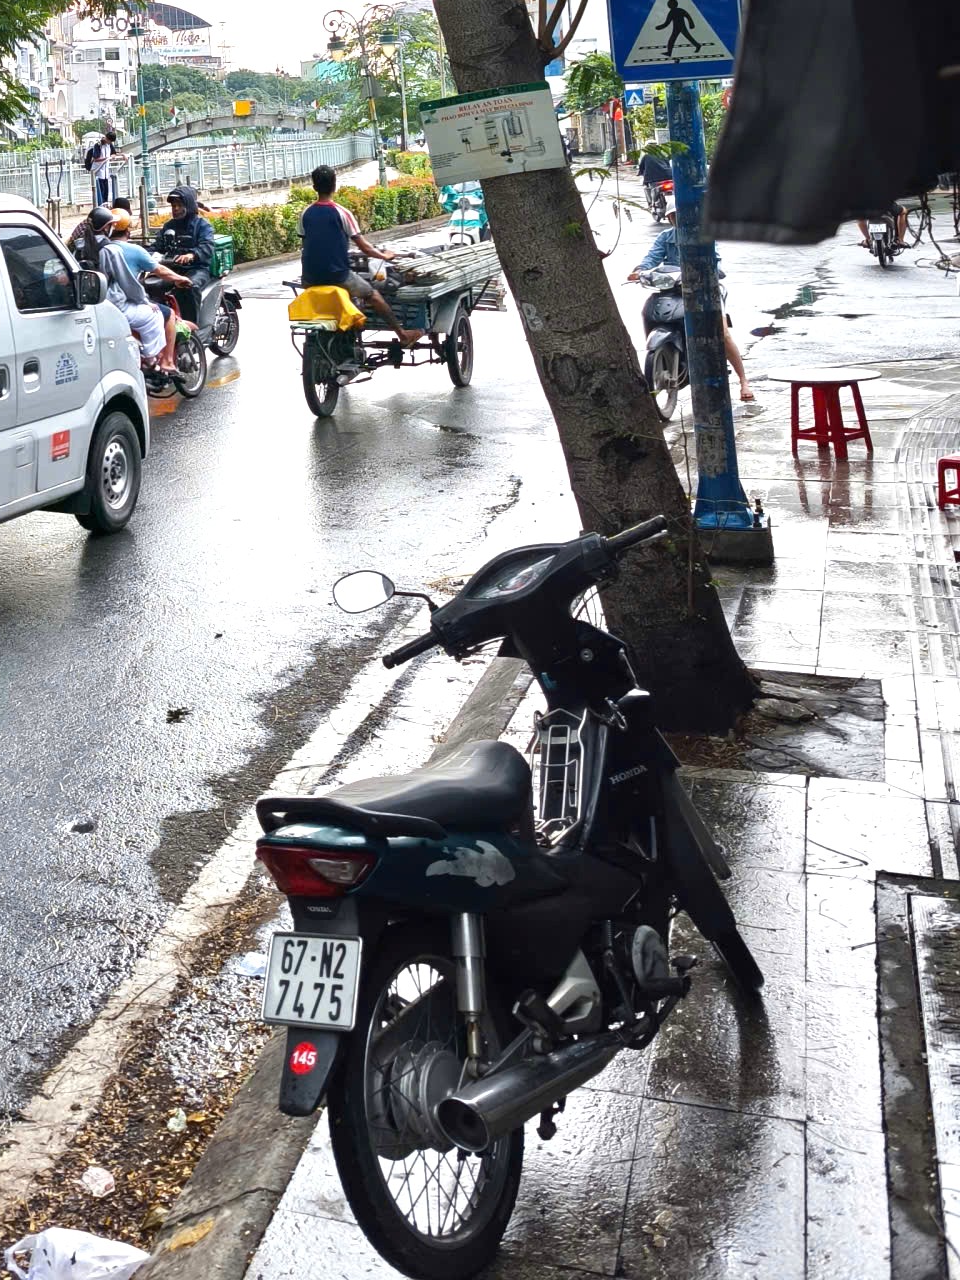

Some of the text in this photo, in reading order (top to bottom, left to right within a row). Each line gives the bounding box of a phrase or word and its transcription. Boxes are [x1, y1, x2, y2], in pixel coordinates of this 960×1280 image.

[609, 765, 648, 784] HONDA
[275, 979, 344, 1022] 7475
[292, 1050, 318, 1066] 145
